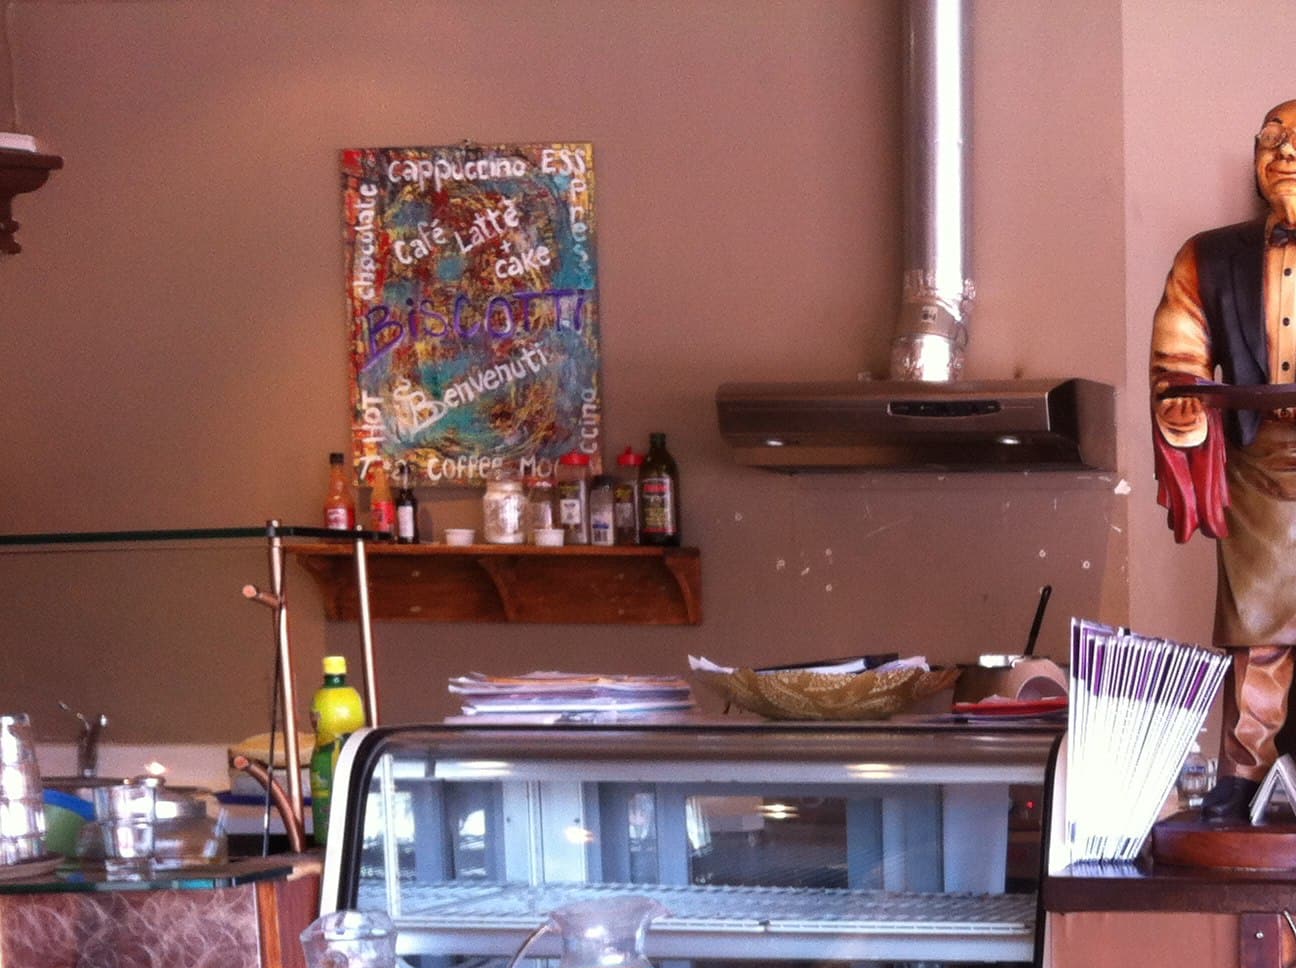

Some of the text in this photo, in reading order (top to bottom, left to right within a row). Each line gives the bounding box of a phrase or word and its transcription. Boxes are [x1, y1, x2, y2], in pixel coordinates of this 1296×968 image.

[388, 158, 526, 192] cappuccino
[353, 184, 379, 300] chocolate
[495, 246, 551, 278] cake
[393, 341, 548, 436] Benvenuti
